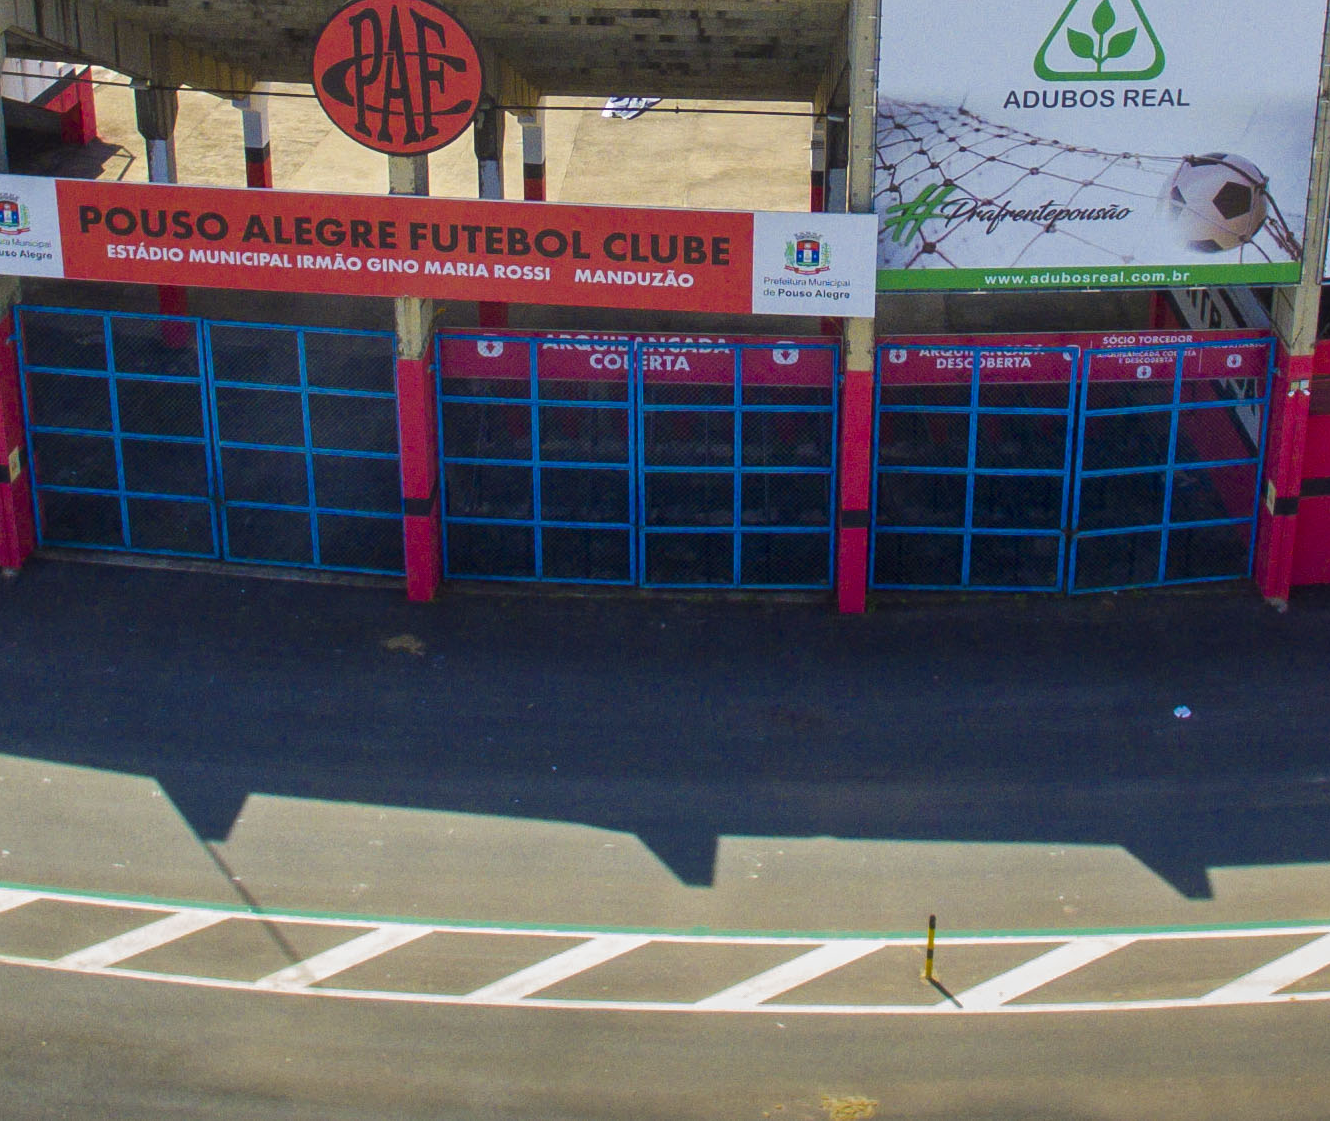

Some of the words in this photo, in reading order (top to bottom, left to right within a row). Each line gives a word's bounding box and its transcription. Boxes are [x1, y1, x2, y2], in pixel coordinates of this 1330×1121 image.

[1003, 89, 1115, 110] ADUBOS
[1123, 87, 1190, 108] REAL
[78, 205, 229, 242] POUSO
[241, 214, 397, 250] ALEGRE
[409, 221, 591, 261] FUTEBOL
[603, 232, 730, 267] CLUBE
[12, 238, 52, 249] Municipal
[19, 250, 53, 262] Alegre
[107, 242, 184, 263] ESTÁDIO
[188, 249, 293, 269] MUNICIPAL
[297, 253, 362, 272] IRMÃO
[366, 258, 419, 275] GINO
[424, 260, 489, 279] MARIA
[494, 264, 551, 281] ROSSI
[574, 268, 694, 289] MANDUZÃO
[763, 276, 806, 288] Prefeitura
[807, 277, 851, 289] Municipal
[984, 270, 1190, 286] www.adubosreal.com.br
[763, 287, 776, 298] de
[778, 288, 812, 299] Pouso
[814, 289, 851, 301] Alegre
[1102, 335, 1136, 345] SÓCIO
[1139, 335, 1193, 344] TORCEDOR
